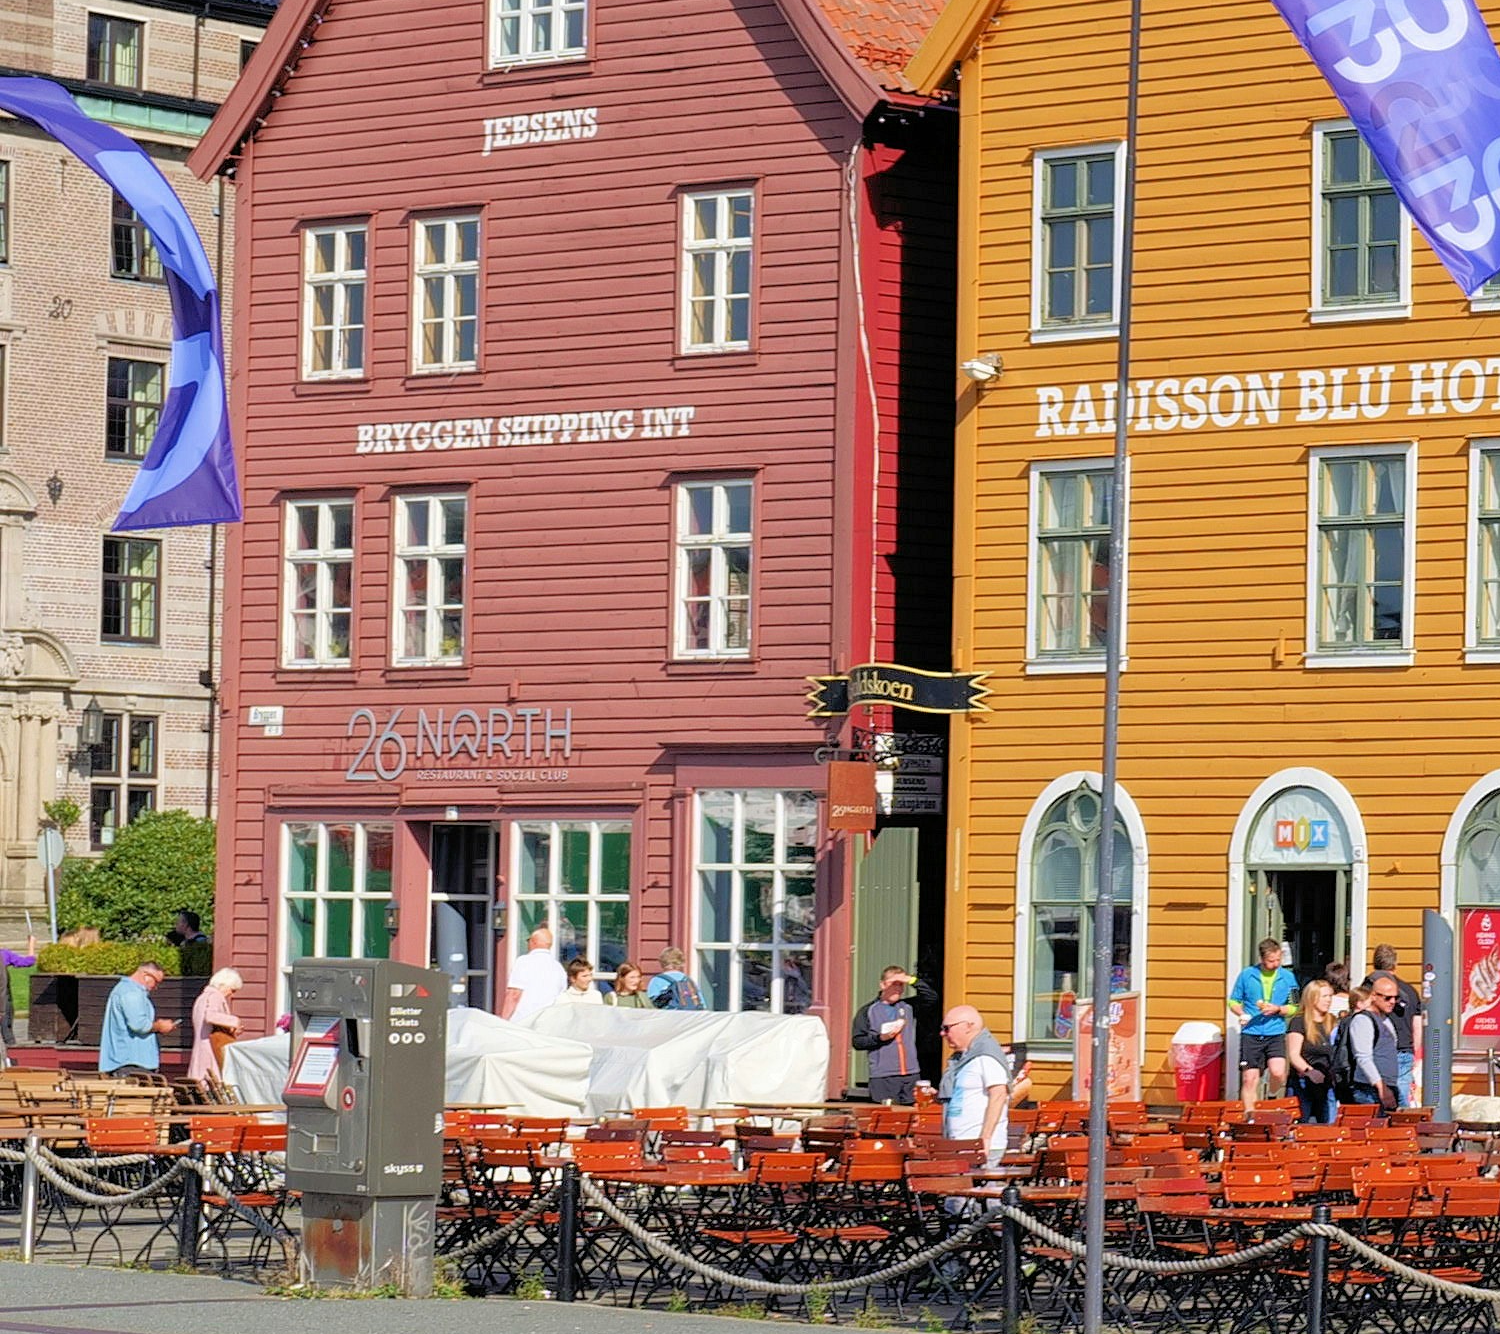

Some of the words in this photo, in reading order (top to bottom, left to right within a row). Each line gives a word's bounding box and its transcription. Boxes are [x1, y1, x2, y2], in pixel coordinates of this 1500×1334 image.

[482, 108, 597, 157] JEBSENS
[1035, 372, 1285, 437] RADISSON
[1296, 365, 1396, 422] BLU
[356, 417, 493, 454] BRYGGEN
[497, 409, 635, 448] SHIPPING
[640, 406, 696, 439] INT
[345, 708, 408, 782] 26
[415, 769, 483, 781] RESTAURANT
[496, 769, 537, 781] SOCIAL
[539, 768, 569, 781] CLUB
[1277, 824, 1326, 842] MIX
[389, 1007, 424, 1016] Billetter
[388, 1017, 420, 1027] Tickets
[384, 1163, 415, 1175] skyss
